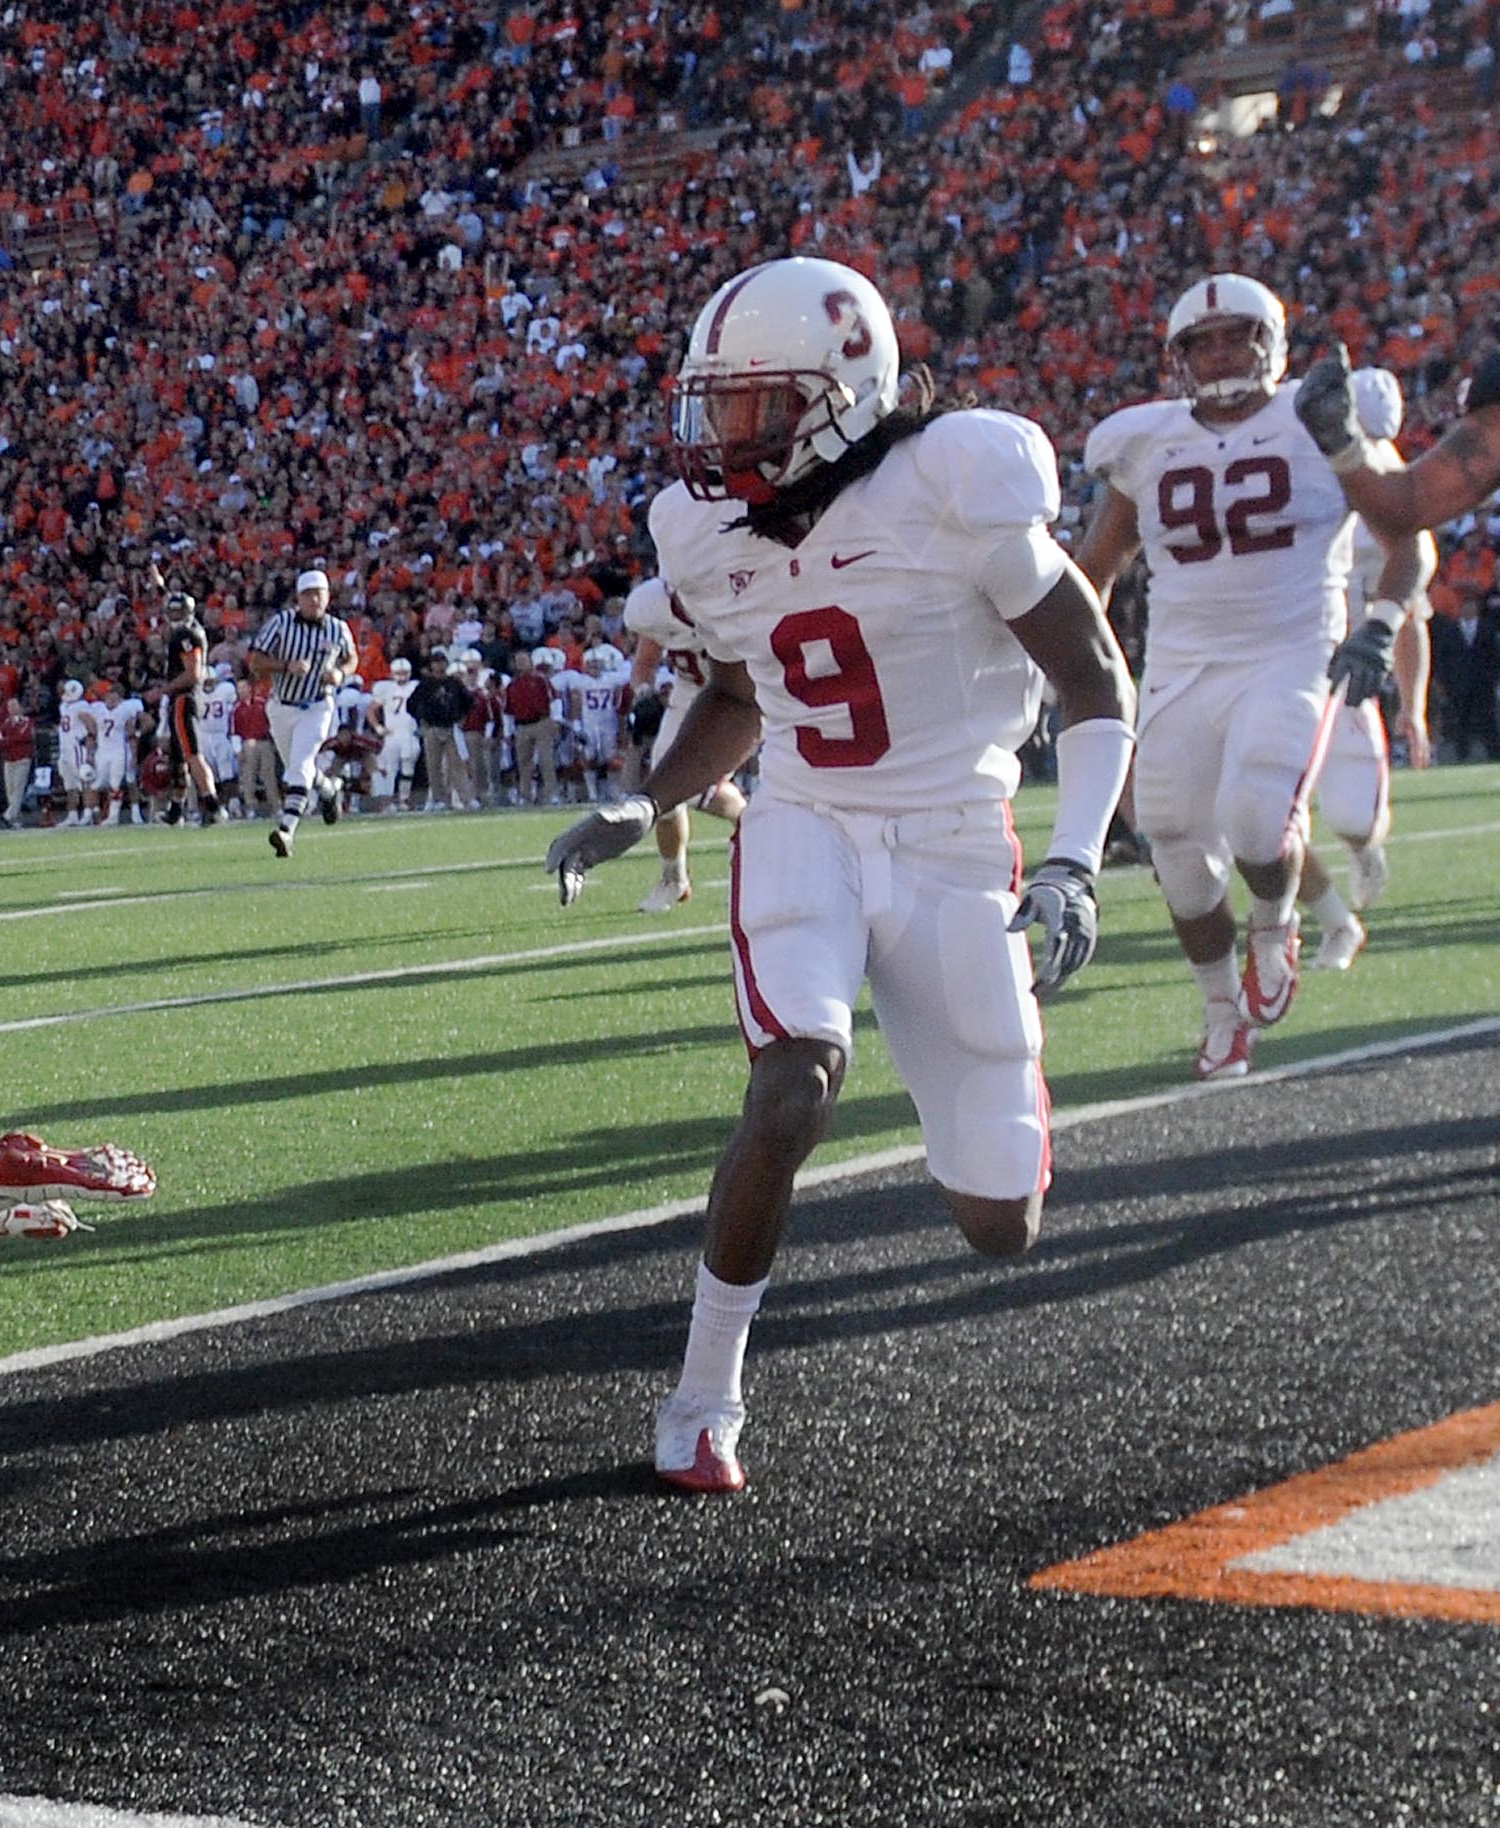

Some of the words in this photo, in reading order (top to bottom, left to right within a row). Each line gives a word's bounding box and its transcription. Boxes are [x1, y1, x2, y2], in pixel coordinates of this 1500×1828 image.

[1158, 456, 1297, 565] 92
[585, 688, 611, 711] 57
[770, 605, 892, 768] 9
[103, 719, 115, 738] 7
